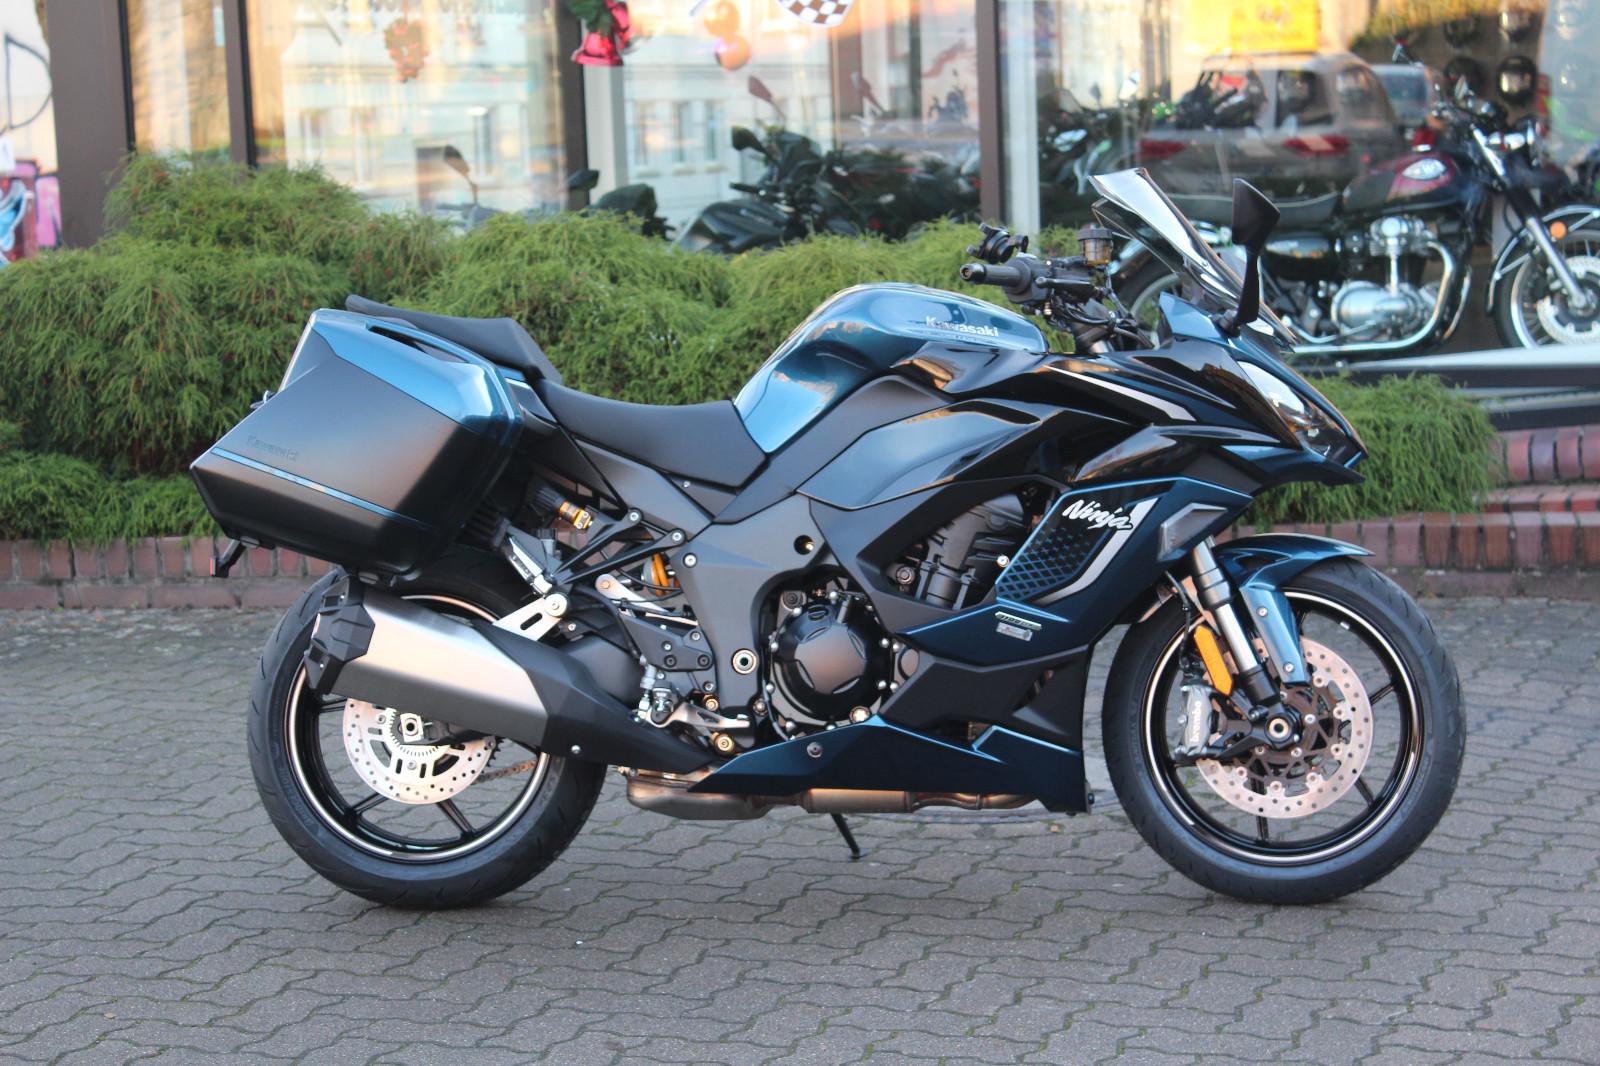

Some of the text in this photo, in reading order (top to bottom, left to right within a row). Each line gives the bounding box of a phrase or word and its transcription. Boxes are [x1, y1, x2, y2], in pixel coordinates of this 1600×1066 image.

[926, 315, 999, 337] Kawasaki
[1062, 499, 1132, 530] Ninja
[1189, 700, 1202, 743] brembo
